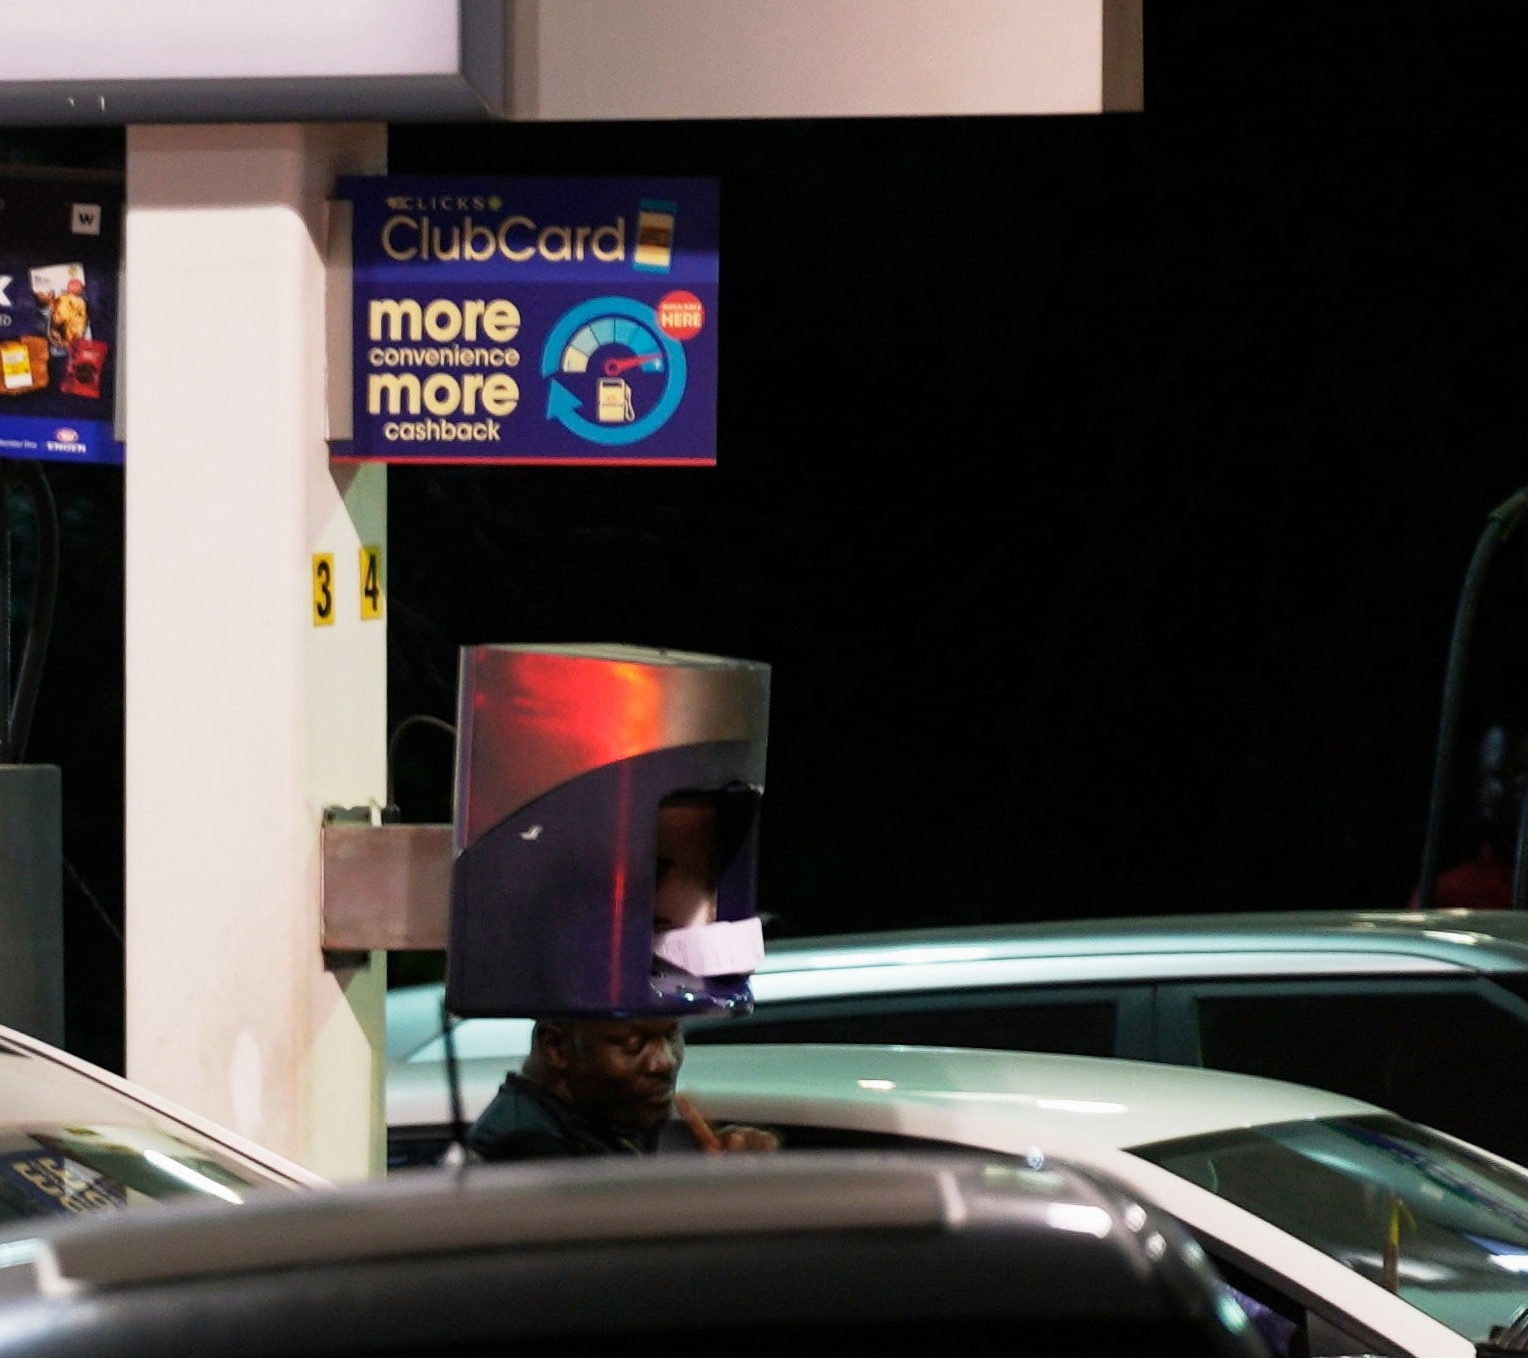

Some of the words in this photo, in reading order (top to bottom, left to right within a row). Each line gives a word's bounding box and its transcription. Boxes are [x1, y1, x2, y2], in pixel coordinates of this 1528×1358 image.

[405, 196, 486, 211] CLICKS
[382, 215, 626, 261] ClubCard
[368, 298, 521, 342] more
[660, 312, 703, 328] HERE
[367, 344, 521, 368] convenience
[367, 372, 520, 416] more
[385, 418, 501, 441] cashback
[316, 561, 332, 619] 3
[364, 554, 380, 613] 4
